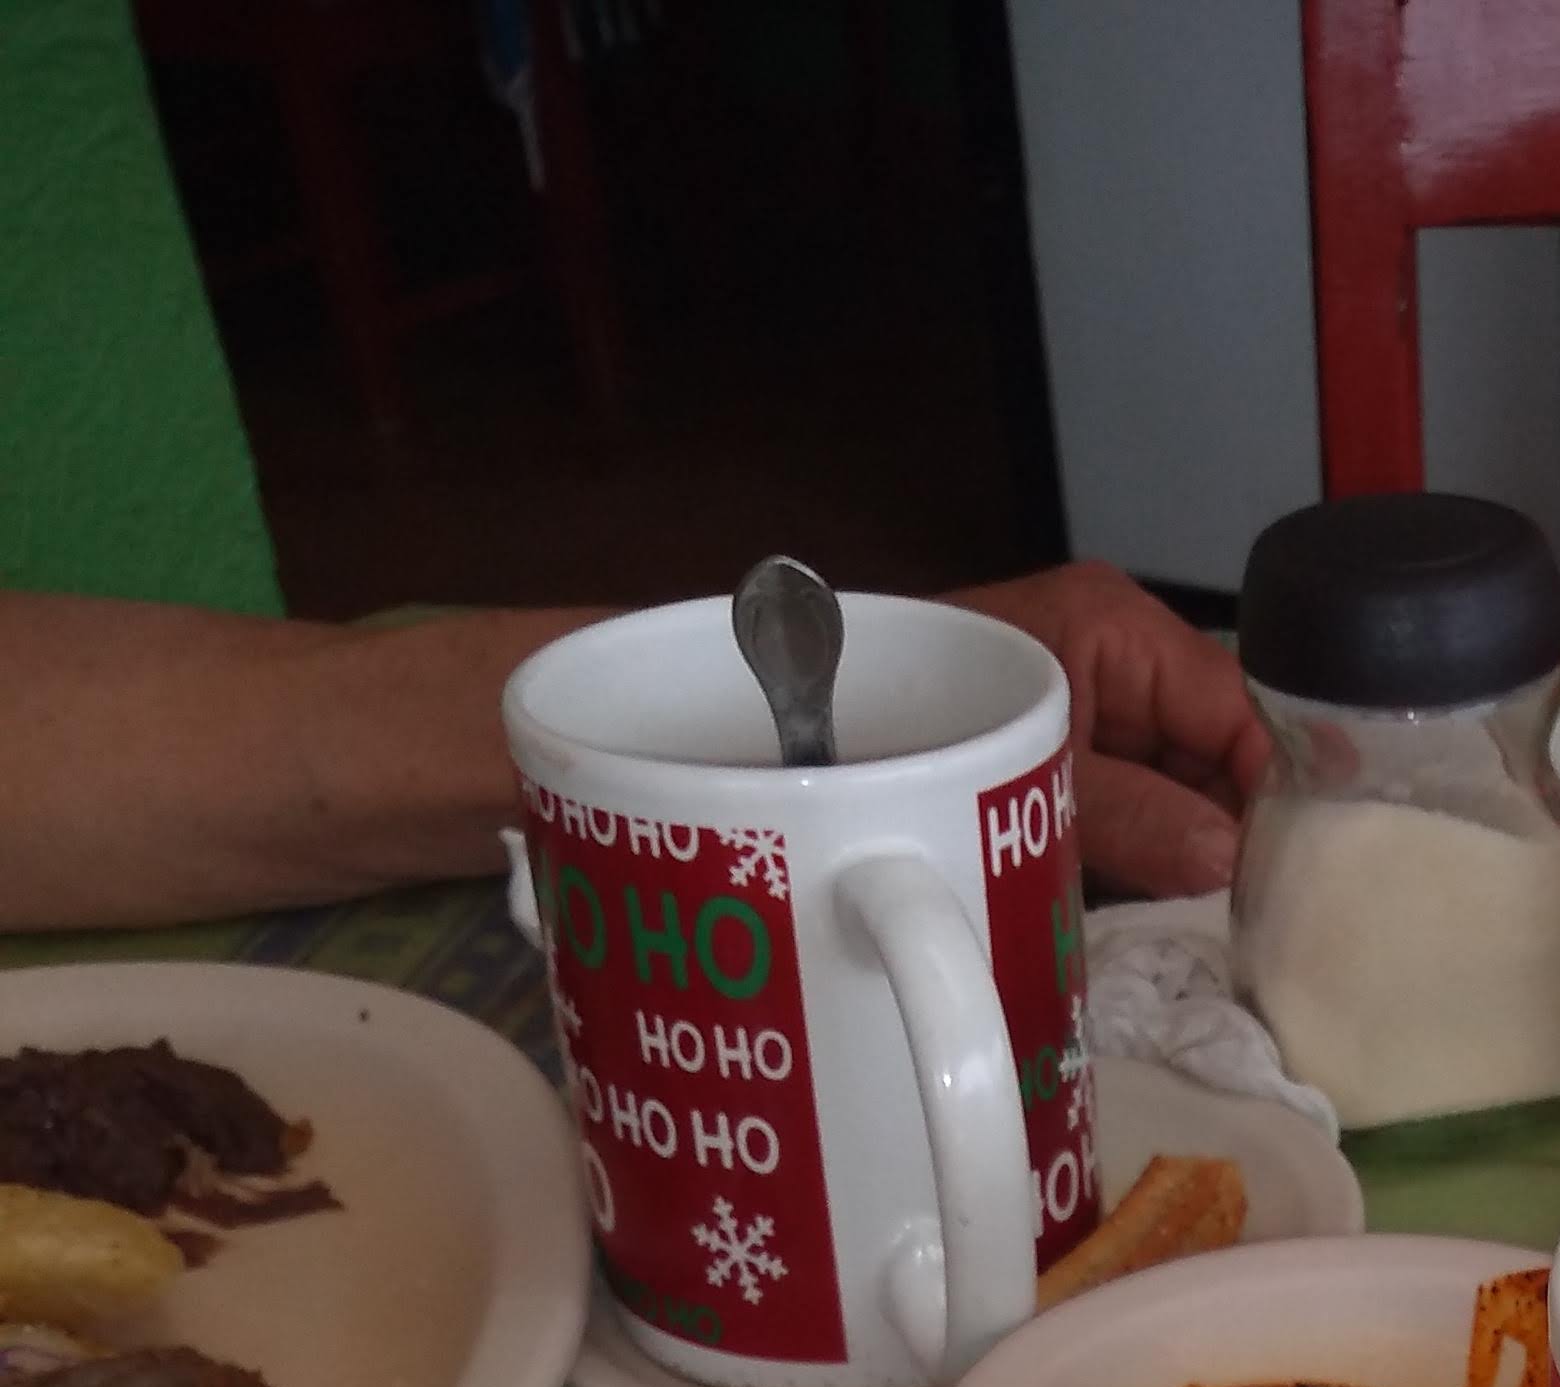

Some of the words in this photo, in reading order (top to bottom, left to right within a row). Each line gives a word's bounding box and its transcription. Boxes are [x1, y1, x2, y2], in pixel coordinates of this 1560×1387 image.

[987, 785, 1049, 878] HO
[623, 883, 773, 999] HO
[635, 1008, 706, 1074] HO
[713, 1023, 794, 1082] HO
[607, 1082, 679, 1159] HO
[690, 1108, 781, 1176] HO
